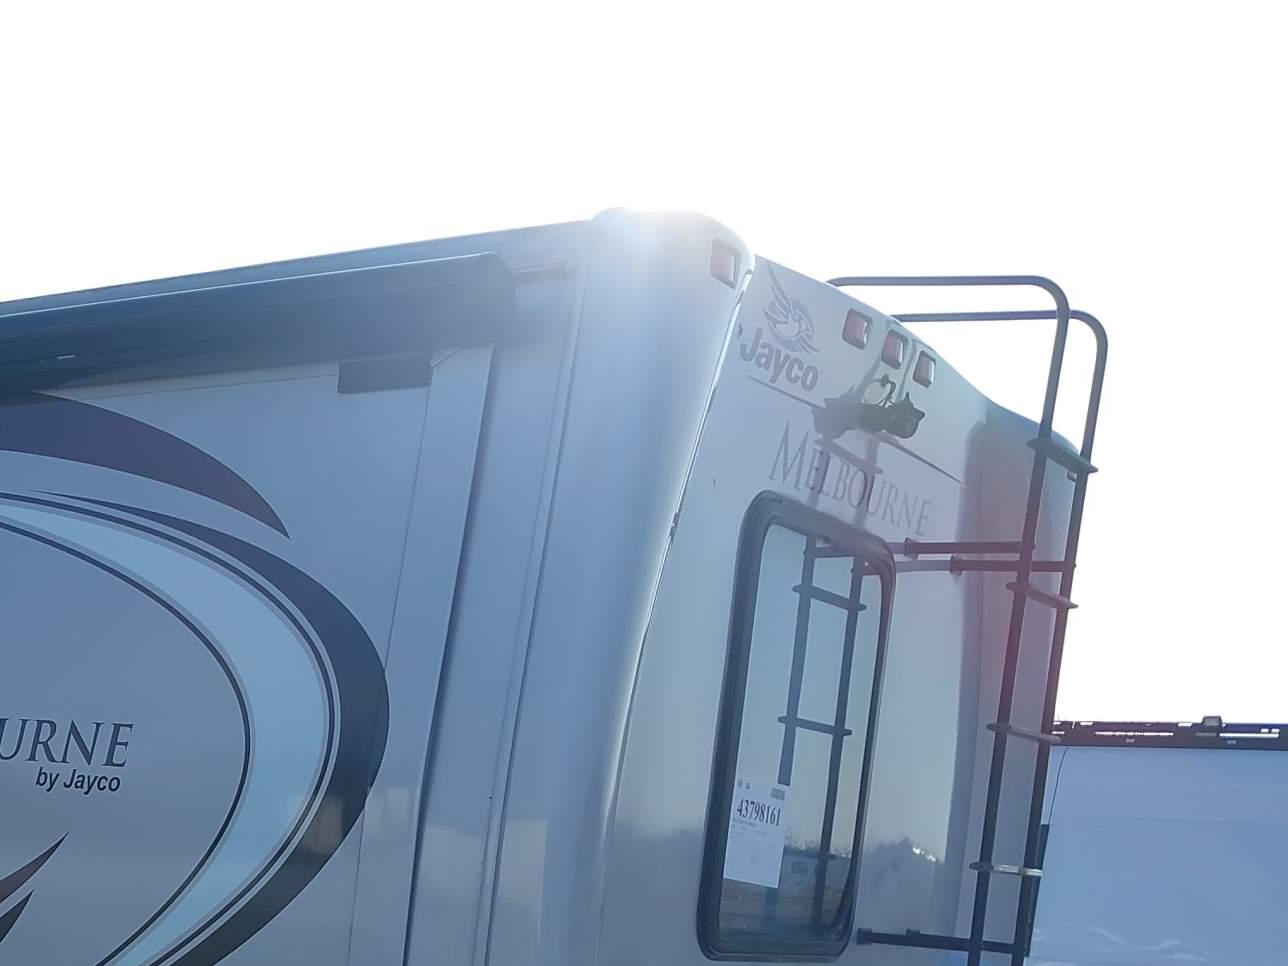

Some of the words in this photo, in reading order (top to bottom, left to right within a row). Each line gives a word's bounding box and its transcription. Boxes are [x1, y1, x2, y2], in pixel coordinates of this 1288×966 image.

[740, 327, 819, 391] Jayco
[769, 421, 931, 536] MELBOURNE
[35, 767, 59, 791] by
[63, 769, 121, 795] Jayco
[737, 799, 781, 826] 43798161
